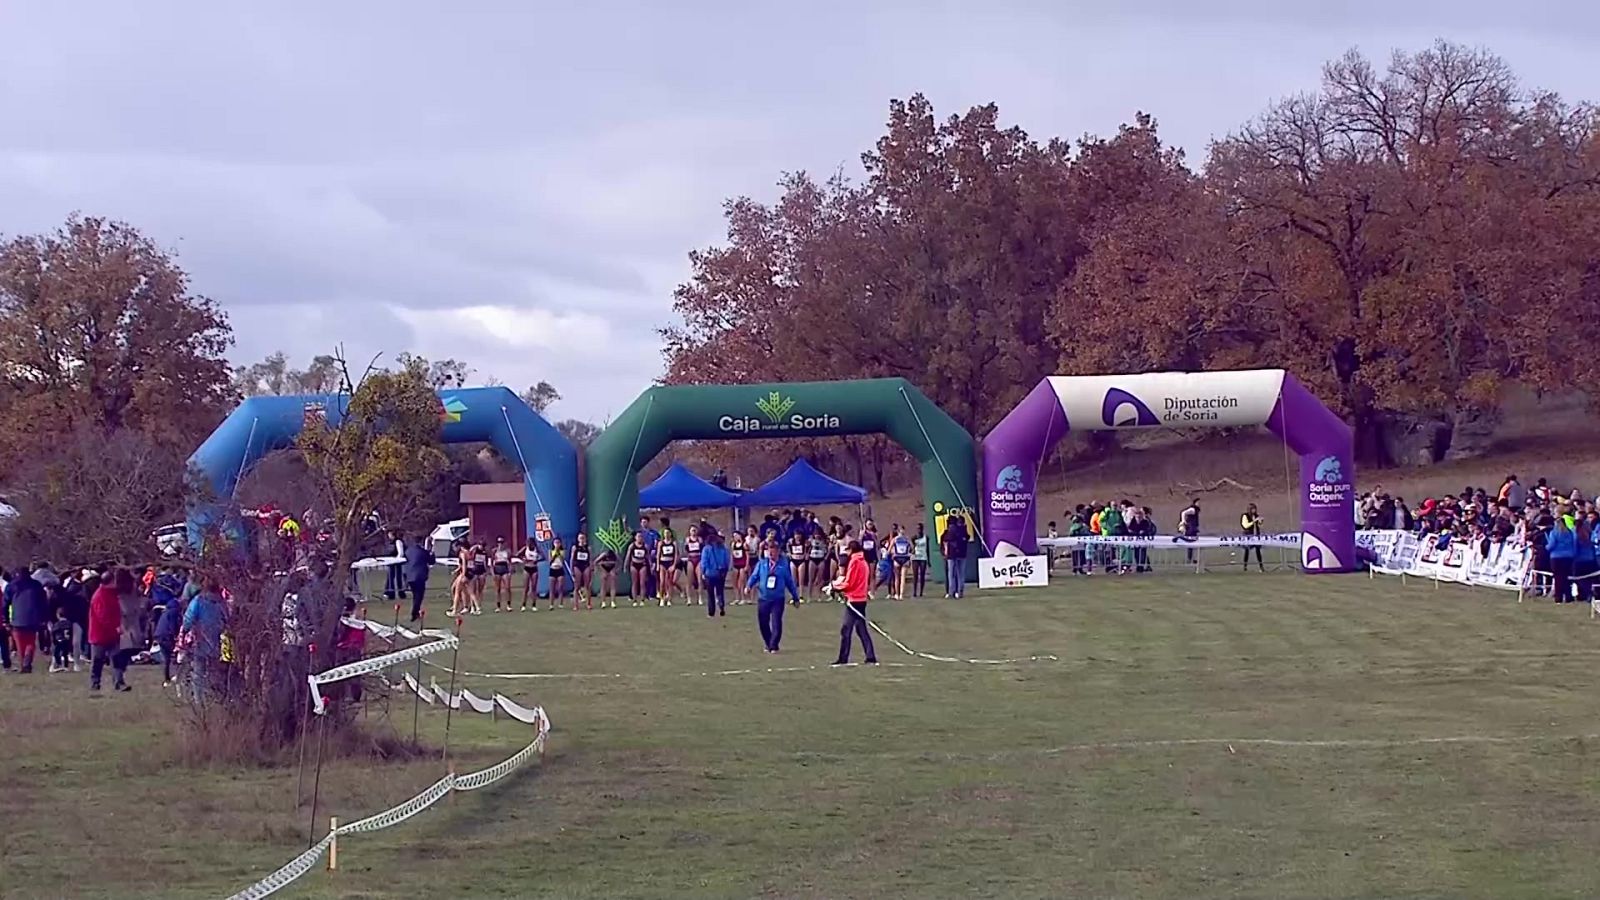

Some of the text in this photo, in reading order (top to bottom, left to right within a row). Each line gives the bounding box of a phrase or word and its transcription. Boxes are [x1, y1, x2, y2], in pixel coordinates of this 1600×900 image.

[1164, 396, 1238, 412] Diputación
[1163, 410, 1218, 421] de Soria
[719, 416, 760, 433] Caja
[791, 414, 840, 429] Soria
[1309, 483, 1332, 492] Soria
[991, 491, 1013, 500] Soria
